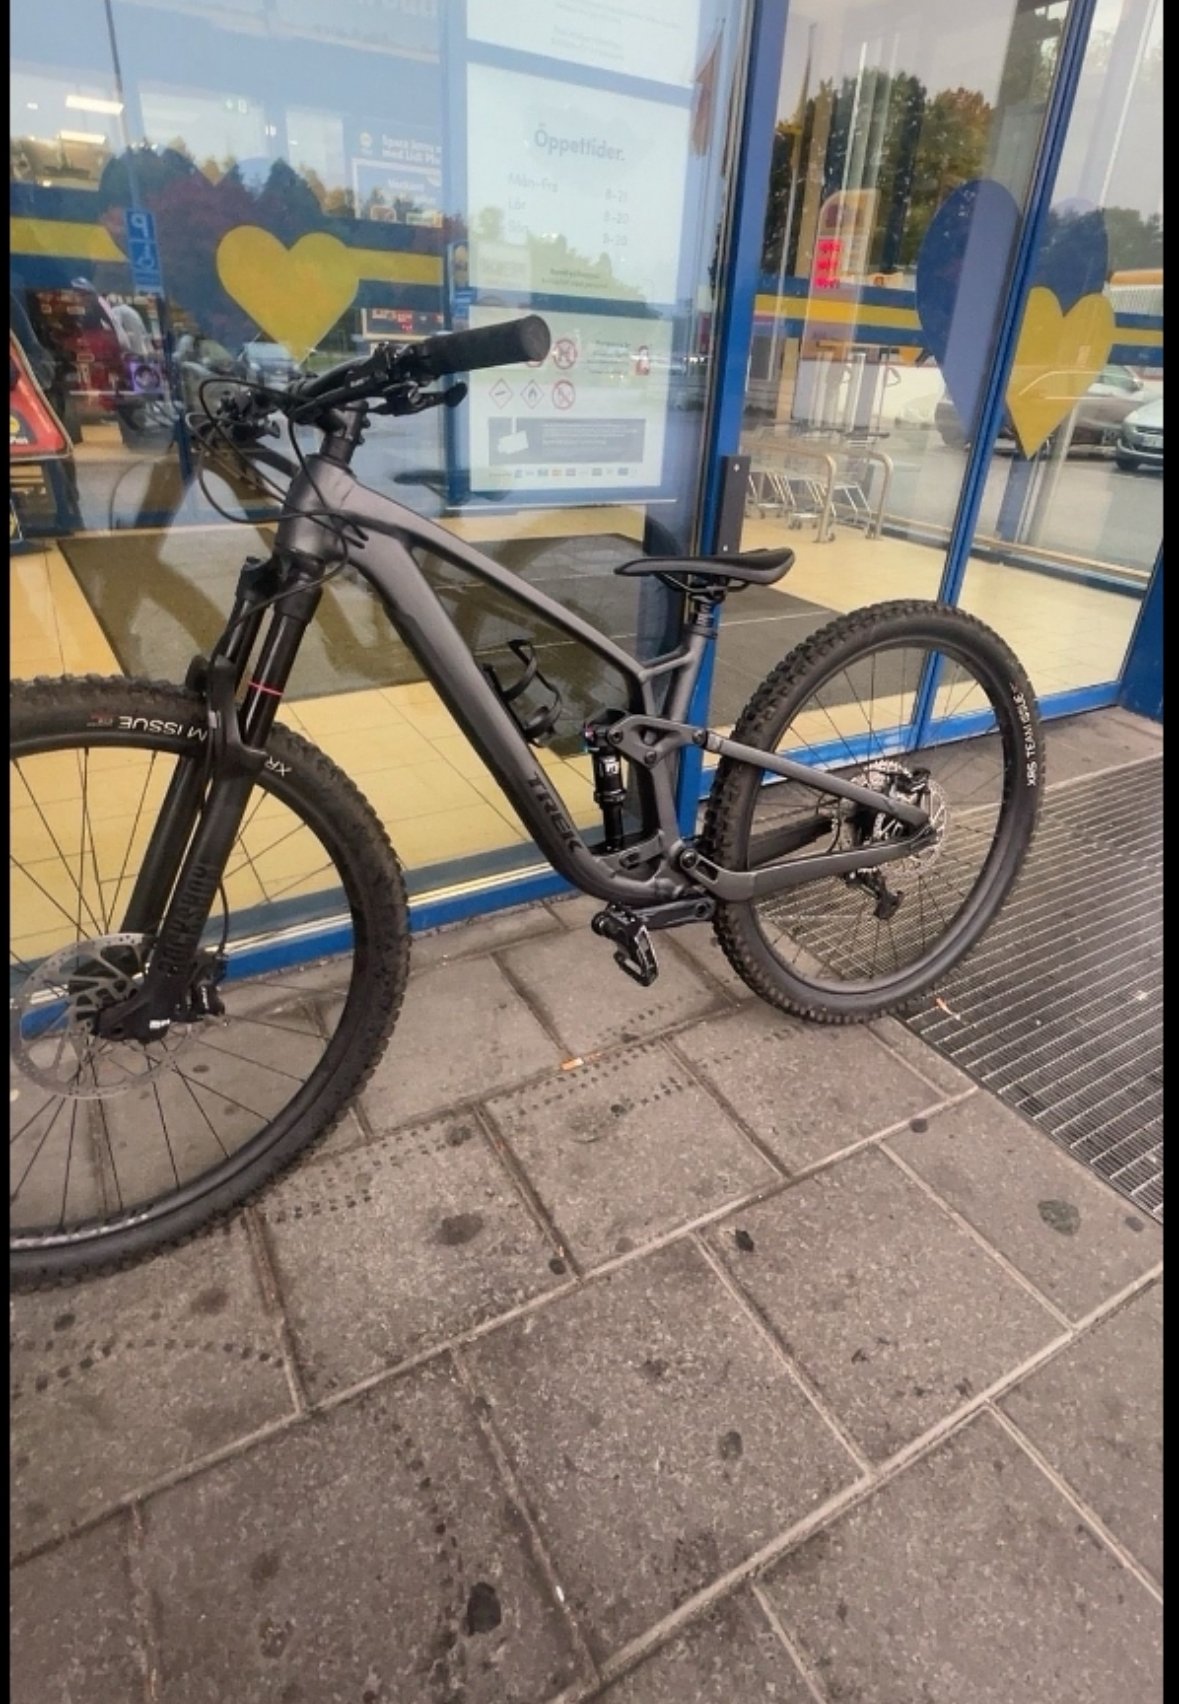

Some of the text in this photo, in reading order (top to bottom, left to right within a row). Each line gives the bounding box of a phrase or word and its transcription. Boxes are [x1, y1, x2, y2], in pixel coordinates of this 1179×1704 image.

[534, 122, 626, 162] Öppettider.
[119, 715, 184, 737] ISSUE
[264, 754, 292, 777] XR
[526, 772, 585, 852] TREK
